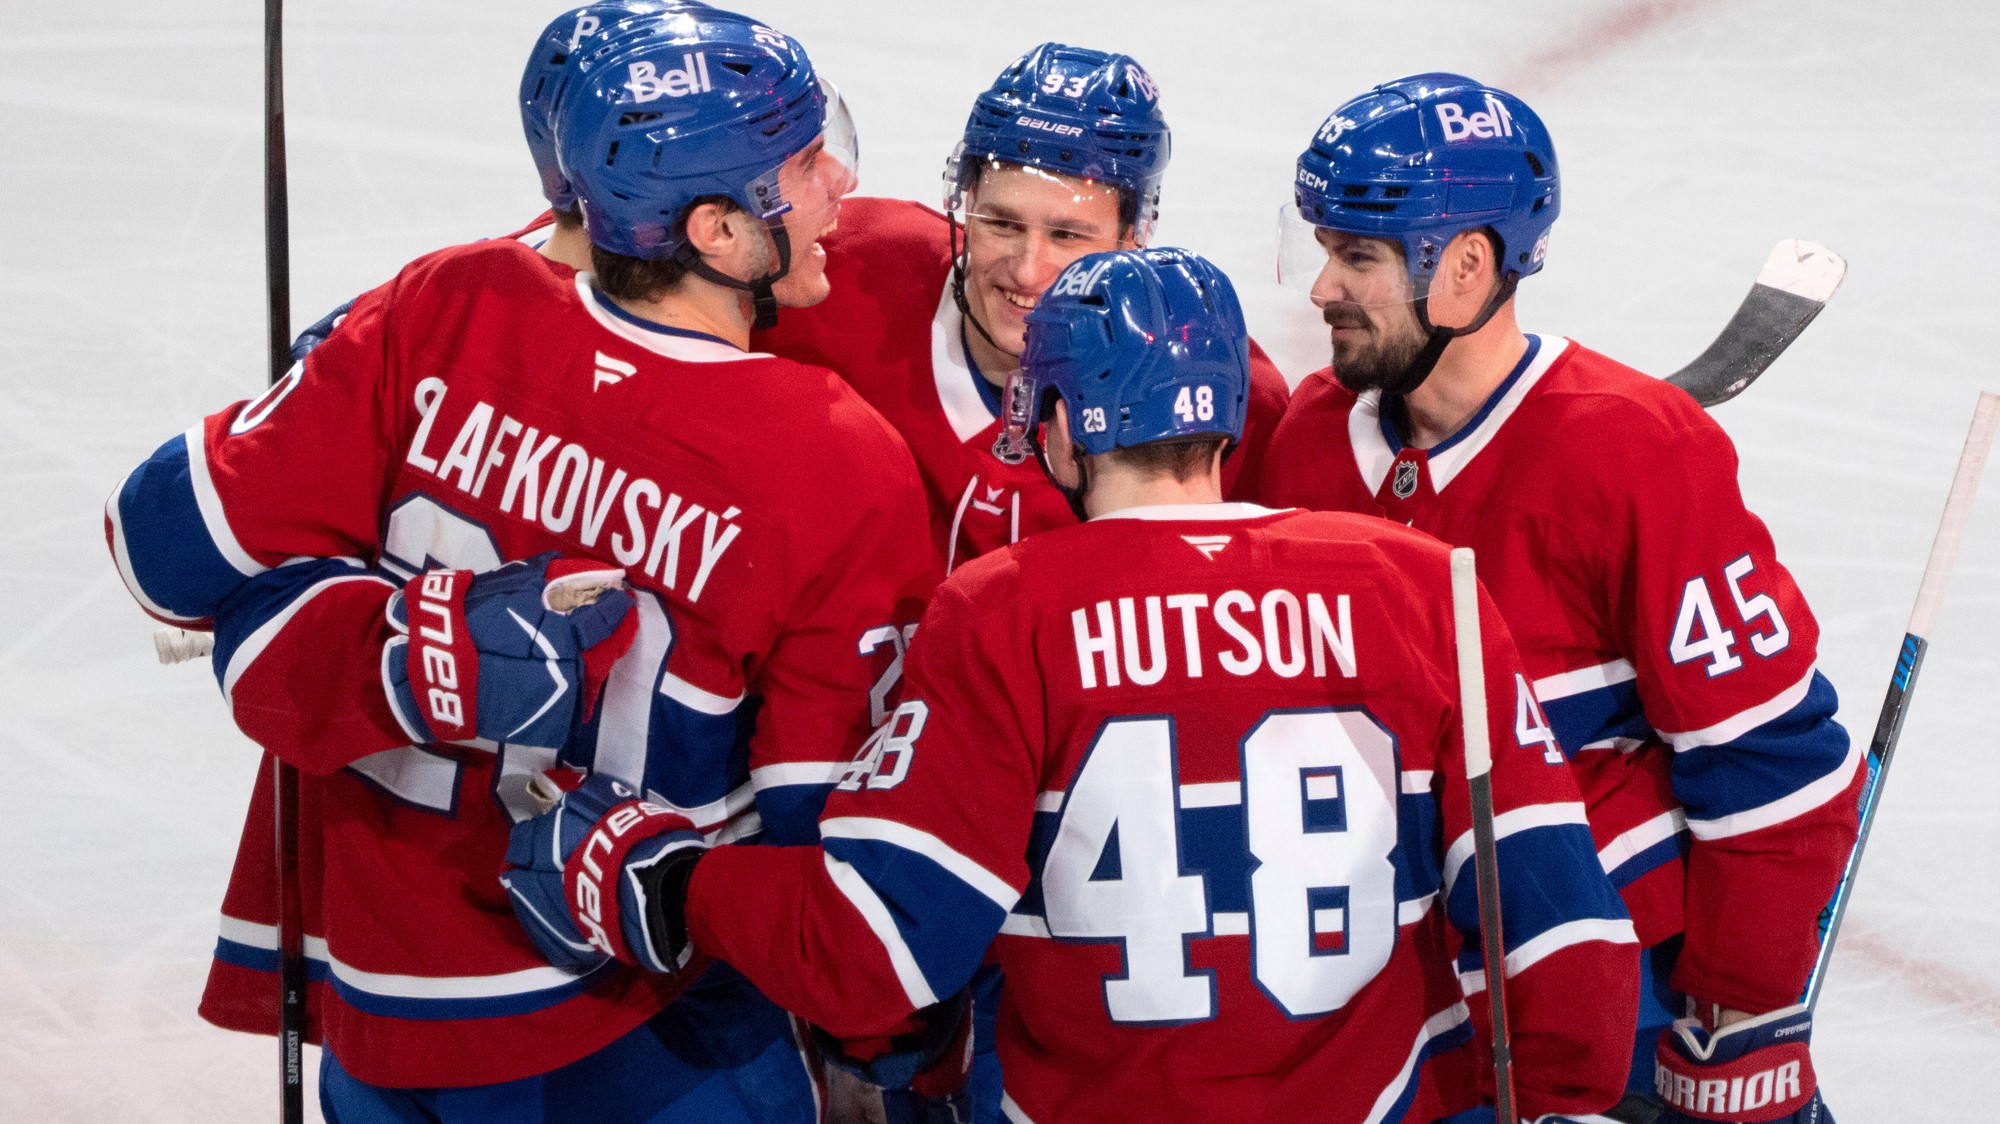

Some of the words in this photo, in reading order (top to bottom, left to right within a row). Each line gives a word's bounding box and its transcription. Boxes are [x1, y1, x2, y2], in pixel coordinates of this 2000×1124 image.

[628, 52, 712, 103] Bell
[1041, 74, 1088, 98] 93
[1015, 115, 1084, 138] BAUER
[1435, 93, 1513, 142] Bell
[1299, 168, 1328, 192] CCM
[1052, 260, 1112, 297] Bell
[1082, 407, 1107, 433] 29
[1174, 385, 1214, 422] 48
[1071, 589, 1358, 689] HUTSON
[1667, 551, 1791, 681] 45
[419, 568, 465, 729] BAUE
[858, 621, 922, 729] 2
[836, 698, 931, 792] 48
[1041, 705, 1402, 1028] 48
[1655, 1059, 1801, 1114] ARRIOR
